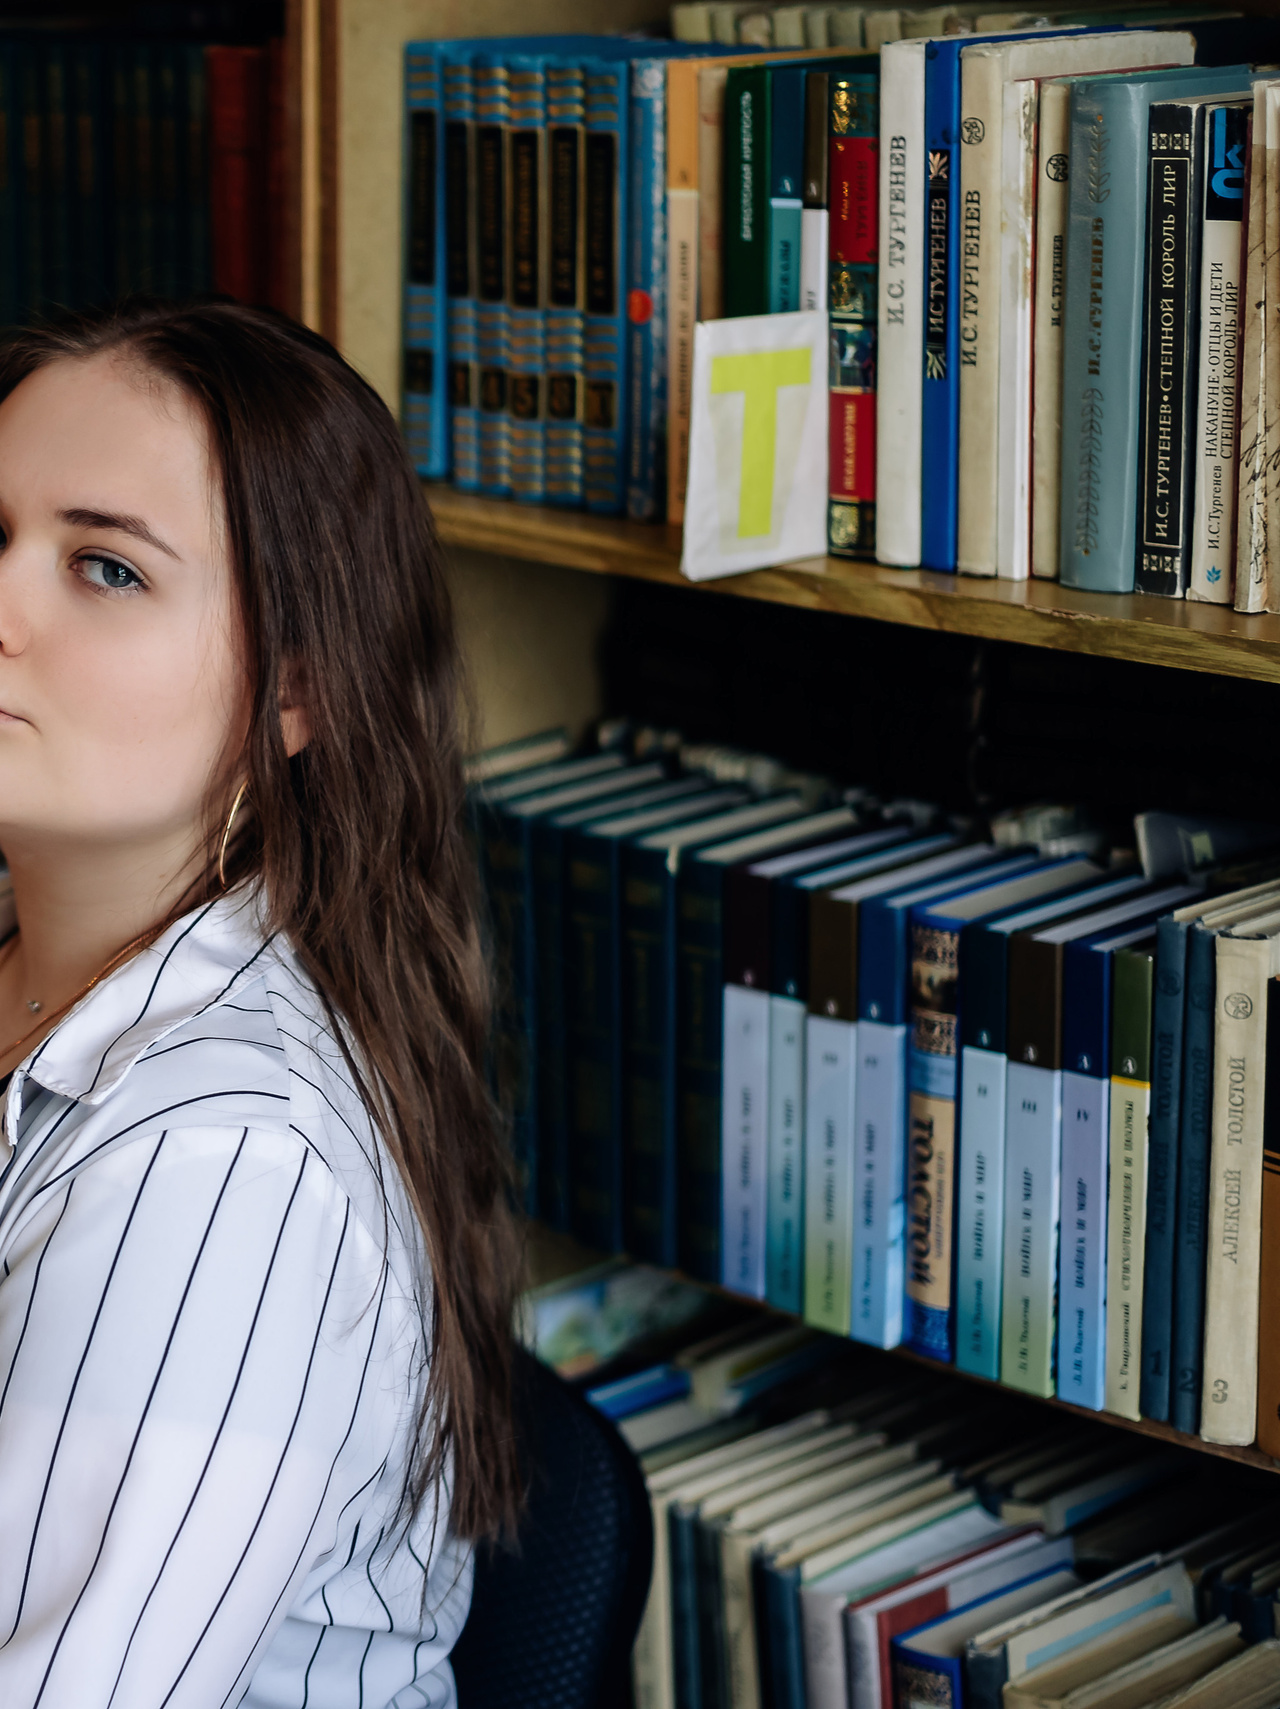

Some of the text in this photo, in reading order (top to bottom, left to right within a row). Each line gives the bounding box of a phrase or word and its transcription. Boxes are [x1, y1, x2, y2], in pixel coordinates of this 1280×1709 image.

[888, 135, 907, 268] ТУРГЕНЕВ
[1162, 165, 1177, 206] ЛИР
[929, 198, 947, 299] ТУРГЕНЕВ
[963, 190, 980, 319] ТУРГЕНЕВ
[1052, 235, 1063, 298] ТУРГЕНЕВ
[1161, 214, 1176, 288] КОРОЛЬ
[1159, 298, 1174, 391] СТЕПНОЙ
[1205, 262, 1224, 457] НАКАНУНЕ ОТЦЫ И ДЕТИ
[1219, 281, 1238, 459] СТЕПНОЙ КОРОЛЬ ЛИР
[711, 348, 812, 538] Т
[1155, 1031, 1173, 1119] ТОЛСТОЙ
[1222, 1056, 1247, 1263] АЛЕКСЕЙ ТОЛСТОЙ
[1179, 1366, 1196, 1393] 2
[1211, 1379, 1229, 1404] 3
